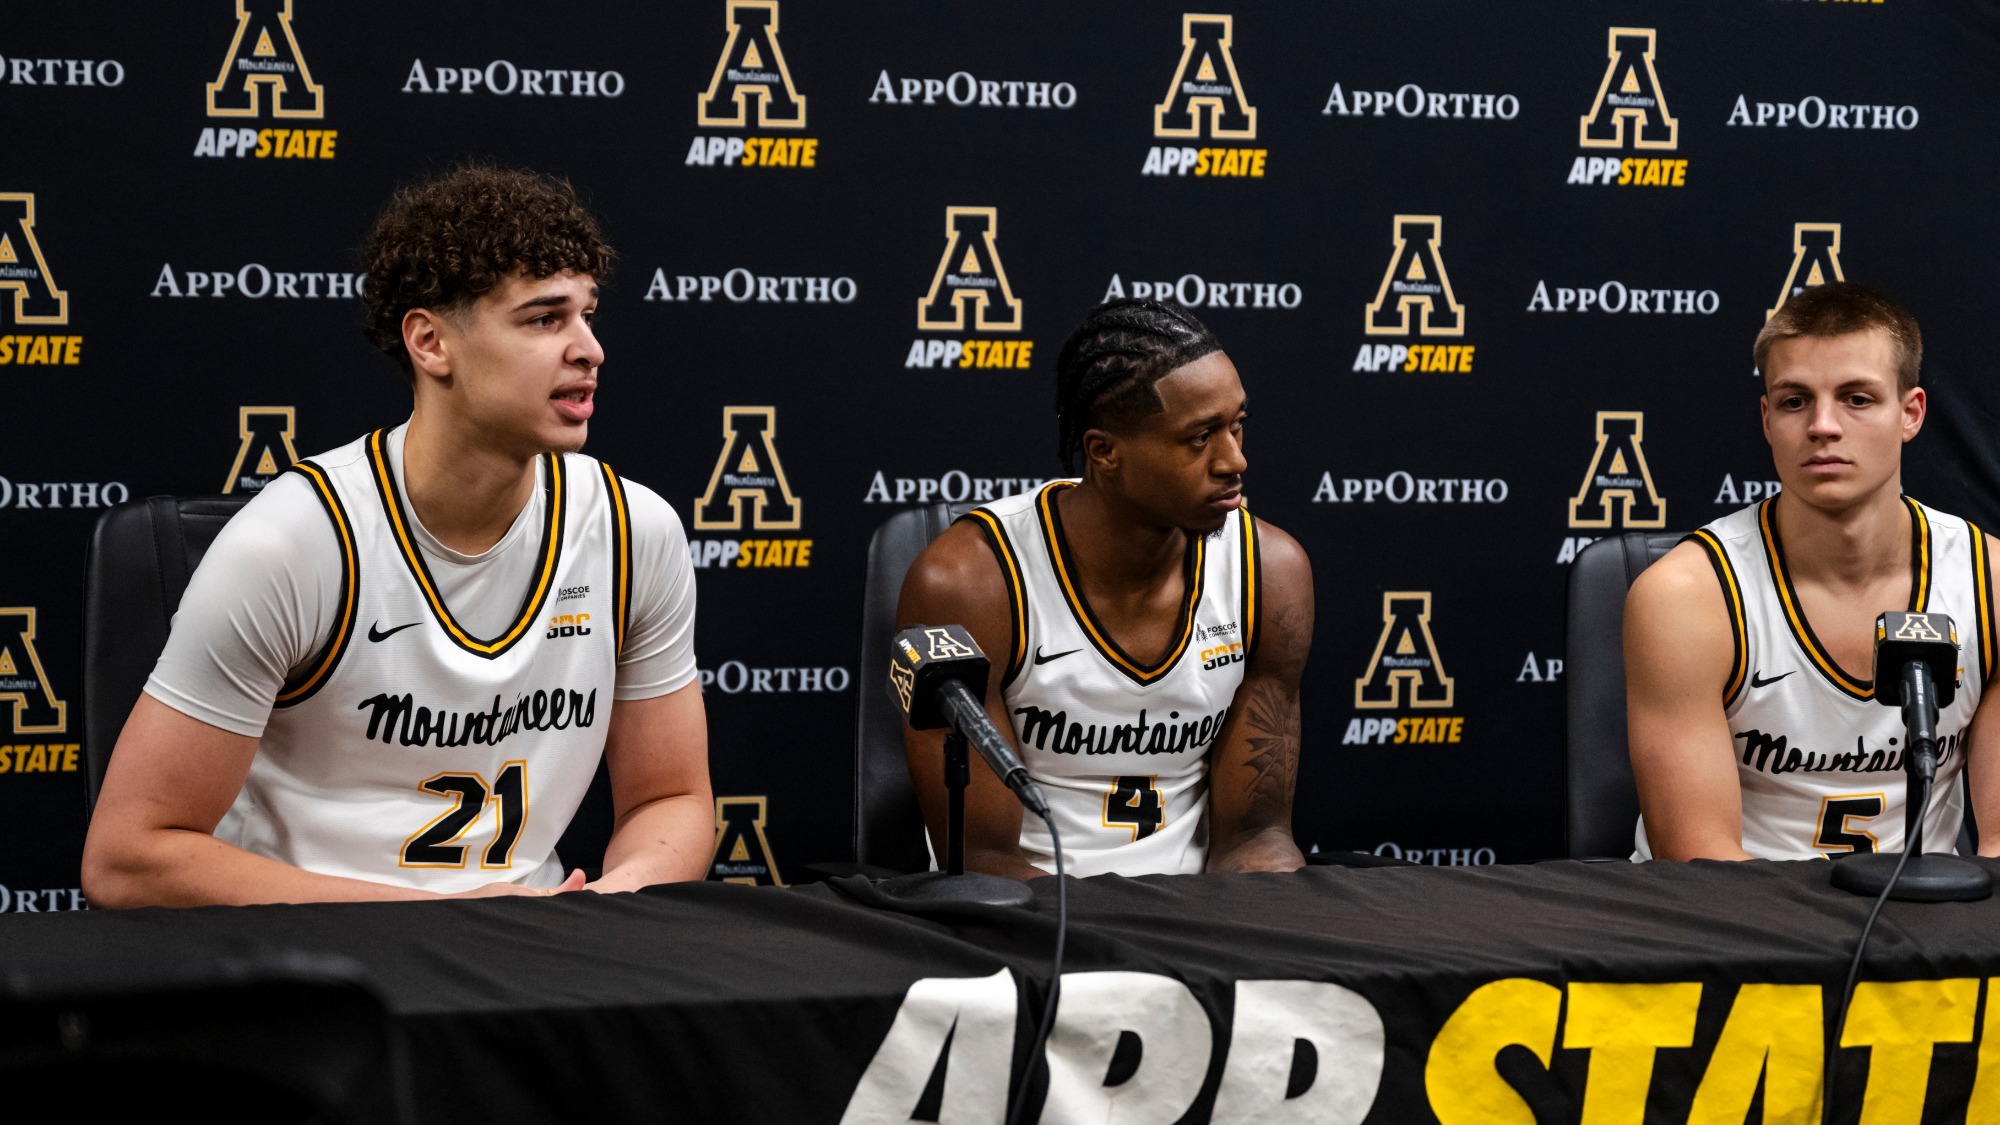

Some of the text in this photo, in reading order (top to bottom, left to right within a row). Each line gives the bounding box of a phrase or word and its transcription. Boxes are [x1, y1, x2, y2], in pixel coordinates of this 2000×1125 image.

[0, 54, 124, 87] RTHO
[207, 0, 324, 118] A
[698, 0, 806, 128] A
[1154, 13, 1257, 139] A
[1580, 27, 1678, 149] A
[194, 128, 337, 159] APPSTATE
[685, 137, 818, 167] APPSTATE
[1142, 147, 1267, 177] APPSTATE
[1567, 157, 1688, 187] APPSTATE
[918, 206, 1022, 331] A
[1365, 215, 1464, 335] A
[905, 340, 1033, 368] APPSTATE
[1353, 344, 1475, 372] APPSTATE
[694, 406, 801, 530] A
[864, 470, 1060, 502] APPORTH
[1569, 411, 1666, 529] A
[559, 586, 590, 596] OSCOE
[698, 660, 849, 694] PORTHO
[1355, 592, 1454, 709] A
[358, 688, 597, 748] Mountaineers
[1014, 706, 1232, 755] Mountainee
[1342, 717, 1464, 745] APPSTATE
[1735, 728, 1964, 774] Mountaier
[398, 759, 530, 870] 21
[1102, 774, 1166, 843] 4
[1812, 792, 1887, 854] 5
[1424, 976, 2000, 1125] STAT
